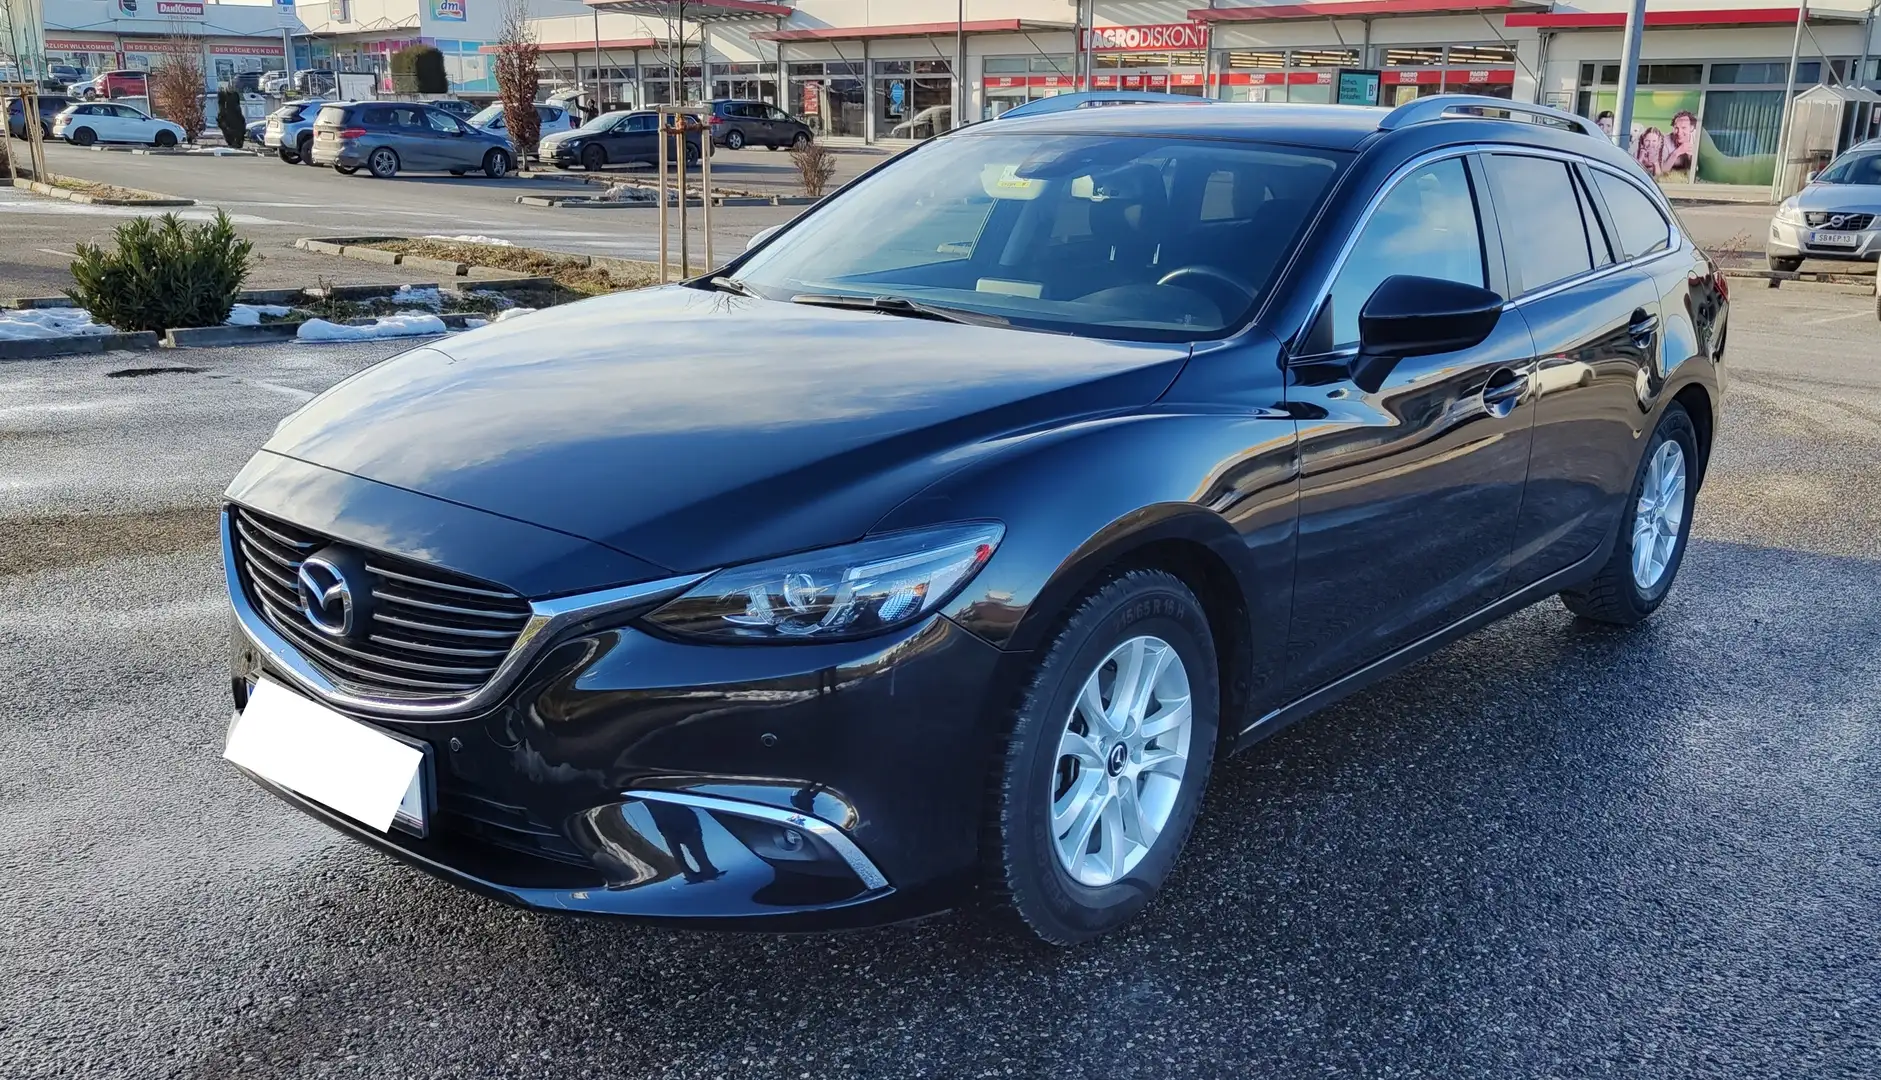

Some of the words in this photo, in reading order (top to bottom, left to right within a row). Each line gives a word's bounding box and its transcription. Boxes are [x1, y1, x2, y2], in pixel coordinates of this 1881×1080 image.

[441, 0, 459, 10] dm
[69, 43, 115, 51] WILLKOMMEN
[1153, 599, 1161, 614] R
[1164, 599, 1175, 615] 16
[1177, 603, 1185, 619] H
